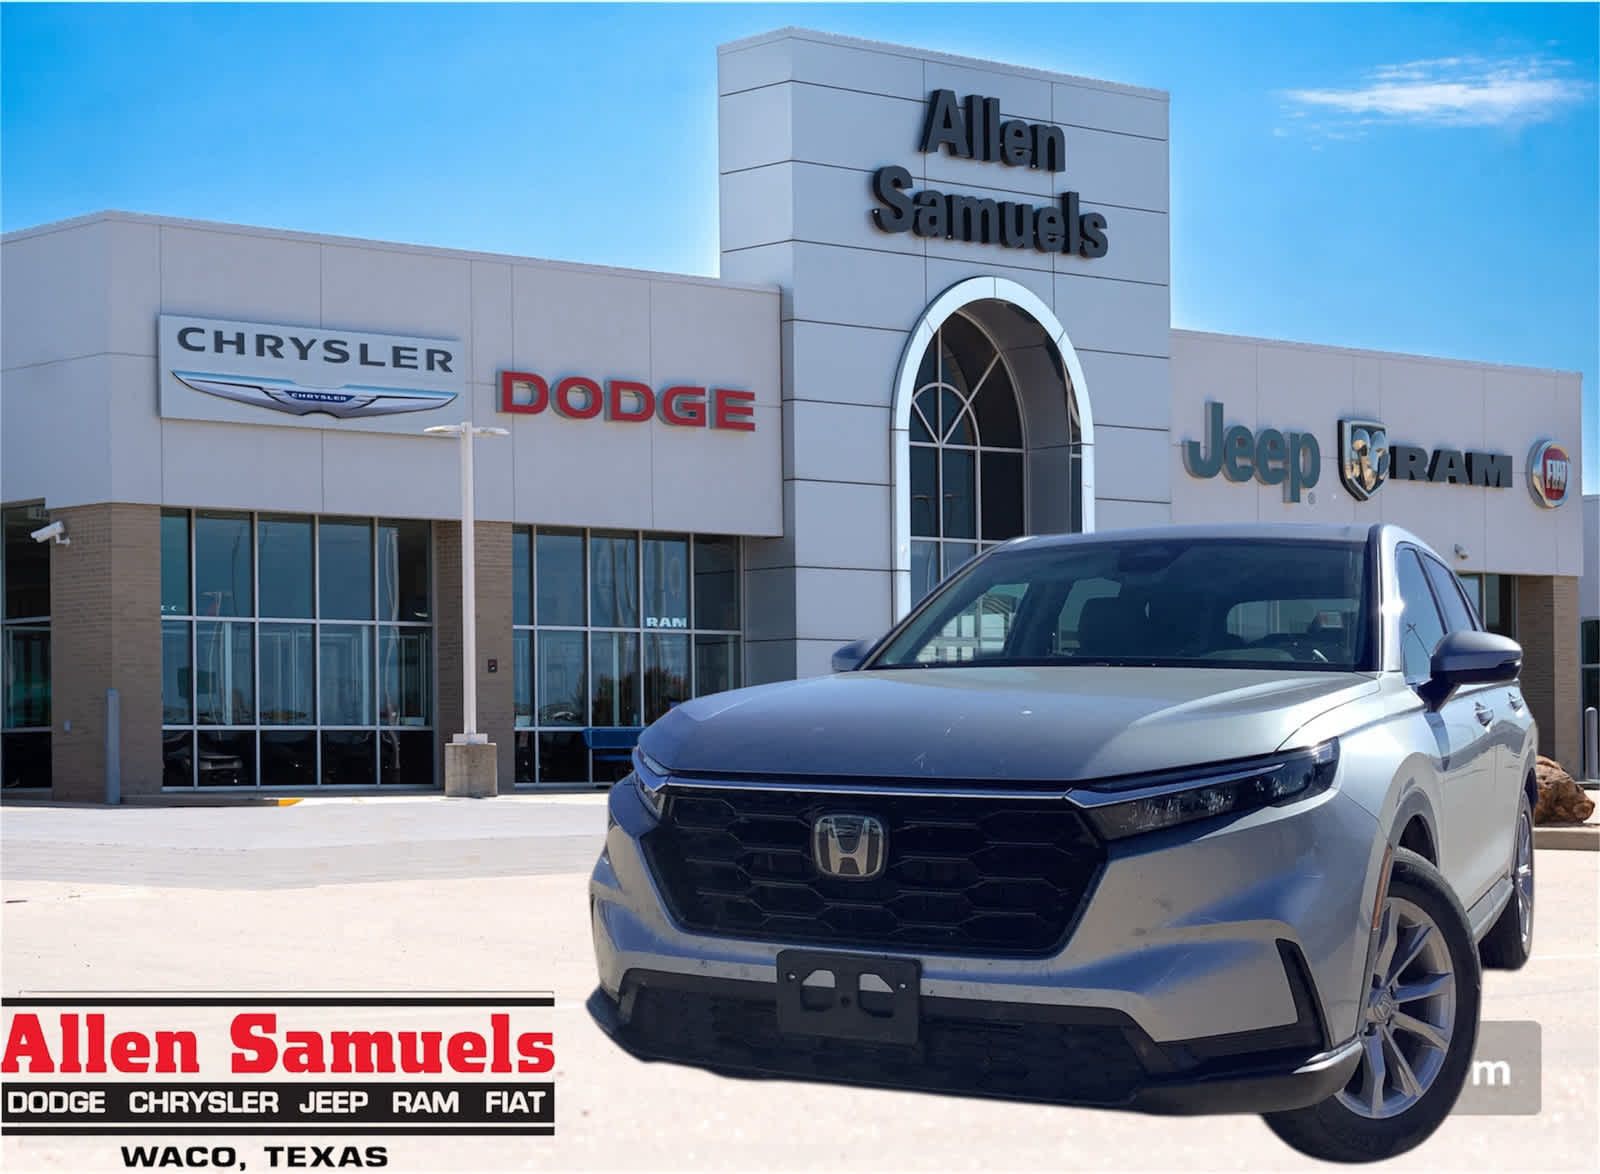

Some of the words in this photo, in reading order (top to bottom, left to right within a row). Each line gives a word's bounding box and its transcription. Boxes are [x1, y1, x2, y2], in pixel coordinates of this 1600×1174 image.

[919, 88, 1066, 172] Allen
[872, 165, 1109, 258] Samuels
[176, 326, 454, 374] CHRYSLER
[290, 392, 347, 401] CHRYSLER
[496, 370, 756, 432] DODGE
[1182, 401, 1321, 504] Jeep
[1390, 445, 1513, 488] RAM
[1545, 459, 1568, 490] FIAT
[646, 616, 687, 628] RAM
